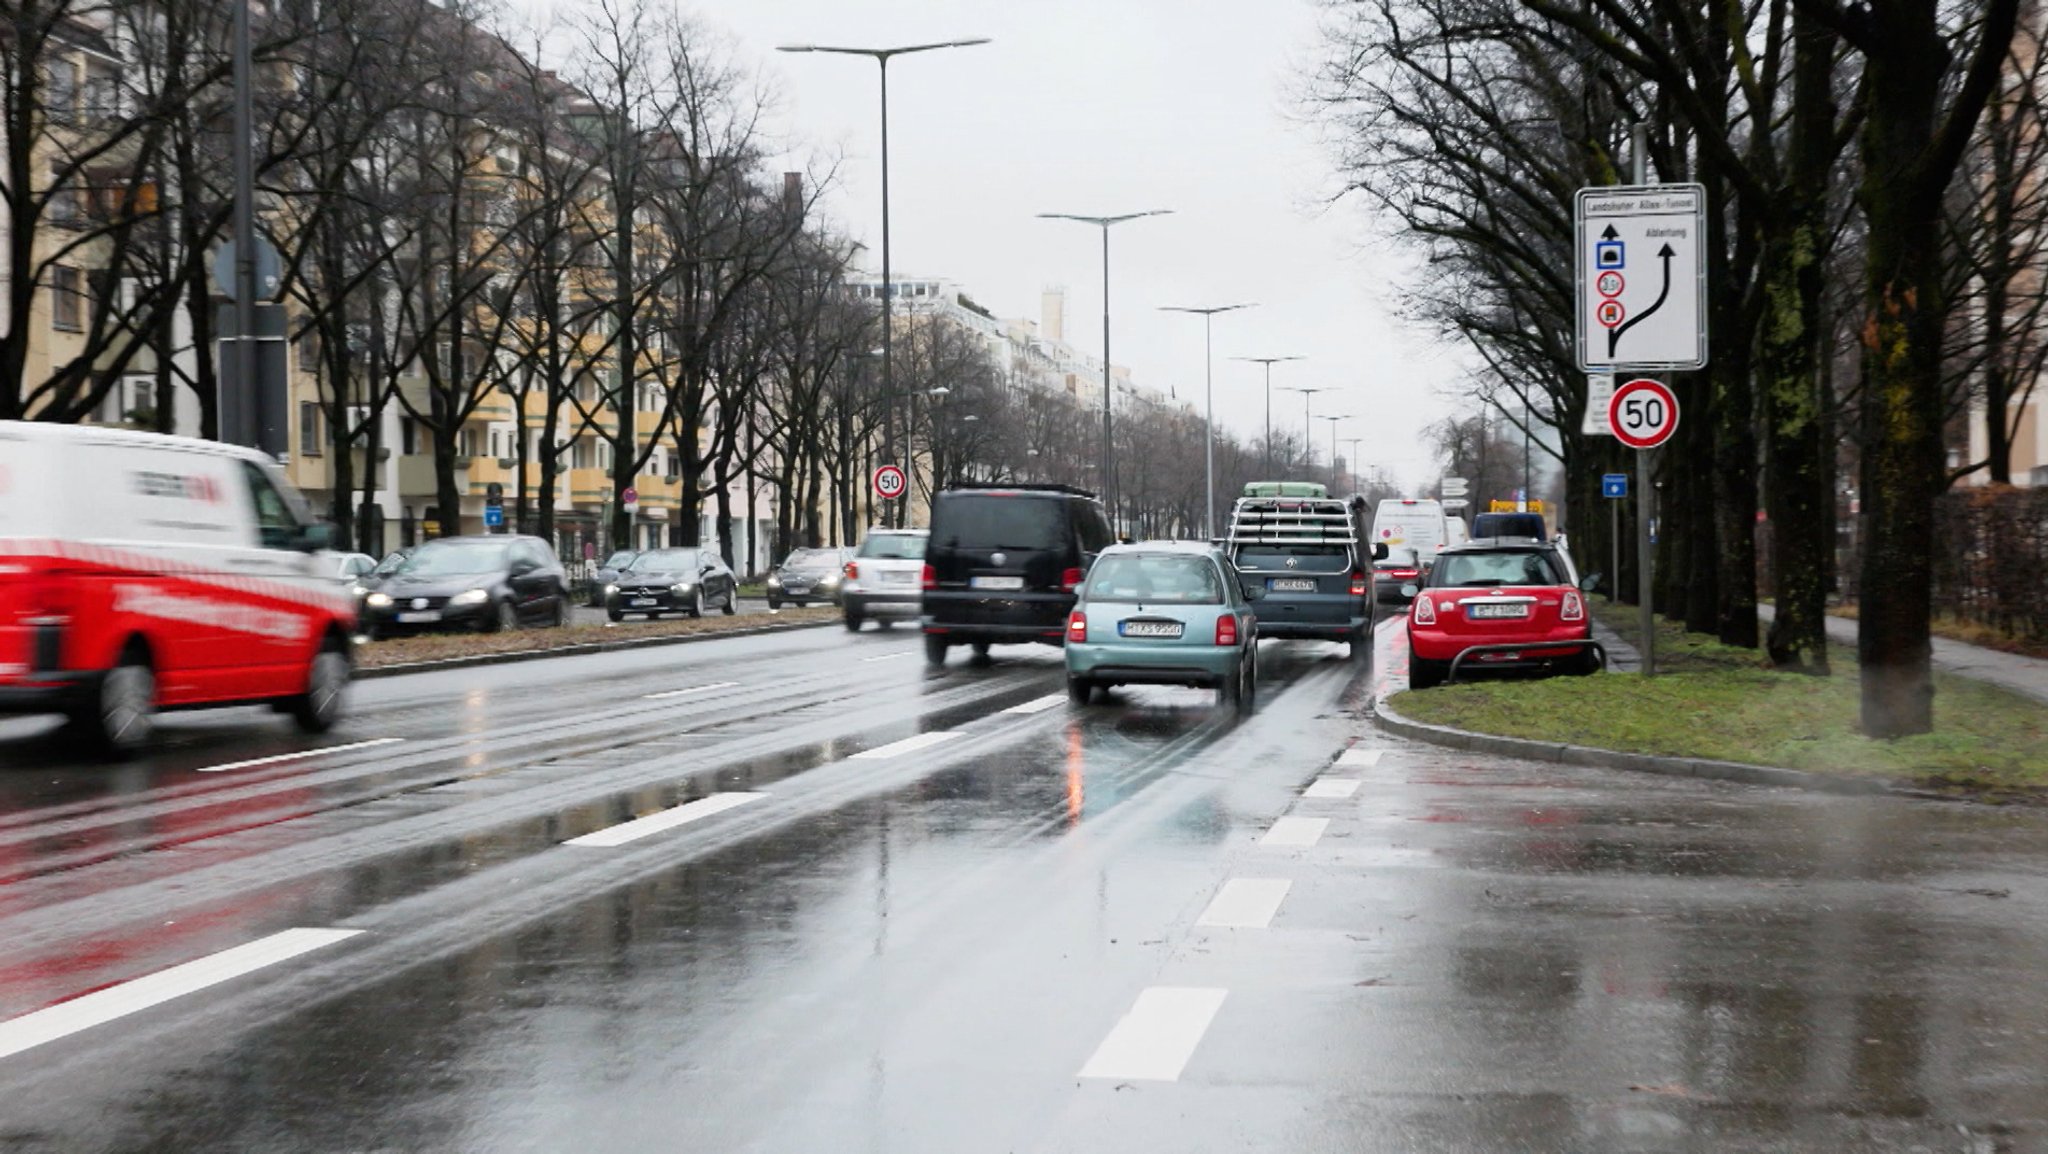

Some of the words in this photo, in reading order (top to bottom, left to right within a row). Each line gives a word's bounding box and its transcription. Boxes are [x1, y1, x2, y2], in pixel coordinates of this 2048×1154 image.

[1587, 201, 1634, 212] Landshuter
[1626, 399, 1662, 428] 50
[882, 474, 899, 489] 50
